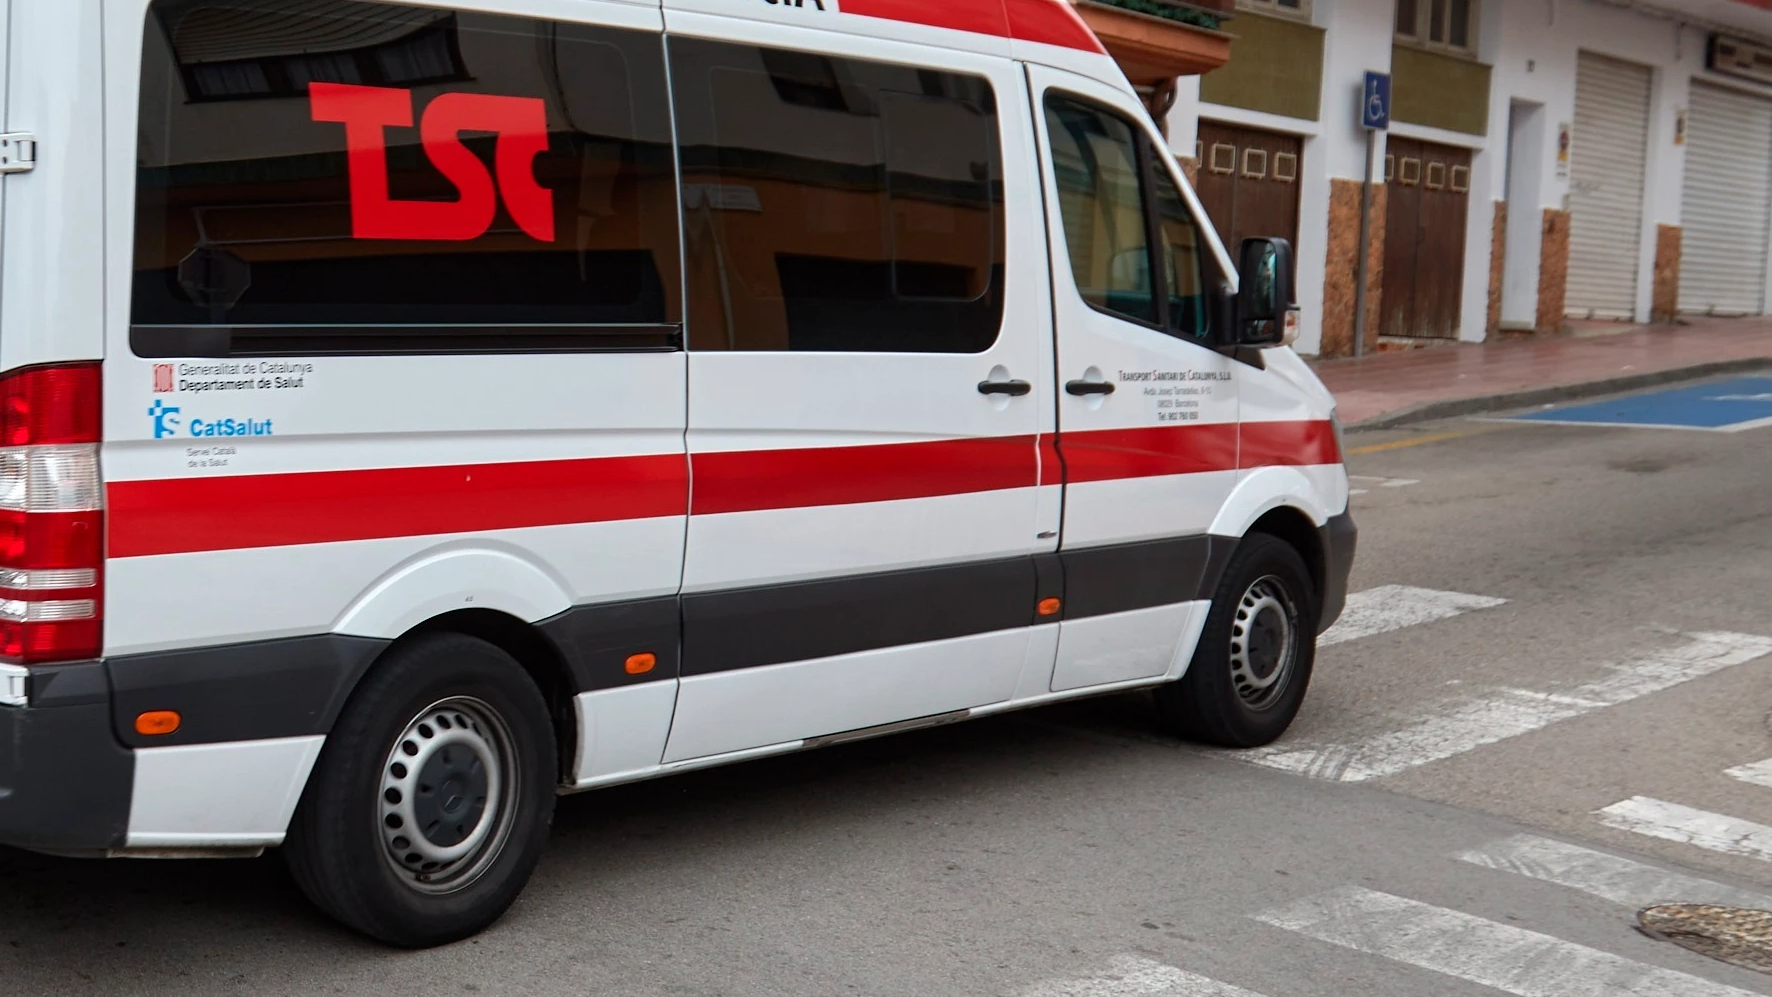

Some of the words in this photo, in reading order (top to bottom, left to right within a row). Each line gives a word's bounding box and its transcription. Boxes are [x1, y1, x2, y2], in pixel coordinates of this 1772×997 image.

[308, 82, 555, 242] TSC
[178, 362, 240, 376] Generalitat
[242, 363, 255, 374] de
[259, 361, 313, 377] Catalunya
[178, 379, 254, 394] Departament
[257, 378, 271, 389] de
[274, 377, 304, 389] Salut
[190, 418, 273, 437] CatSalut
